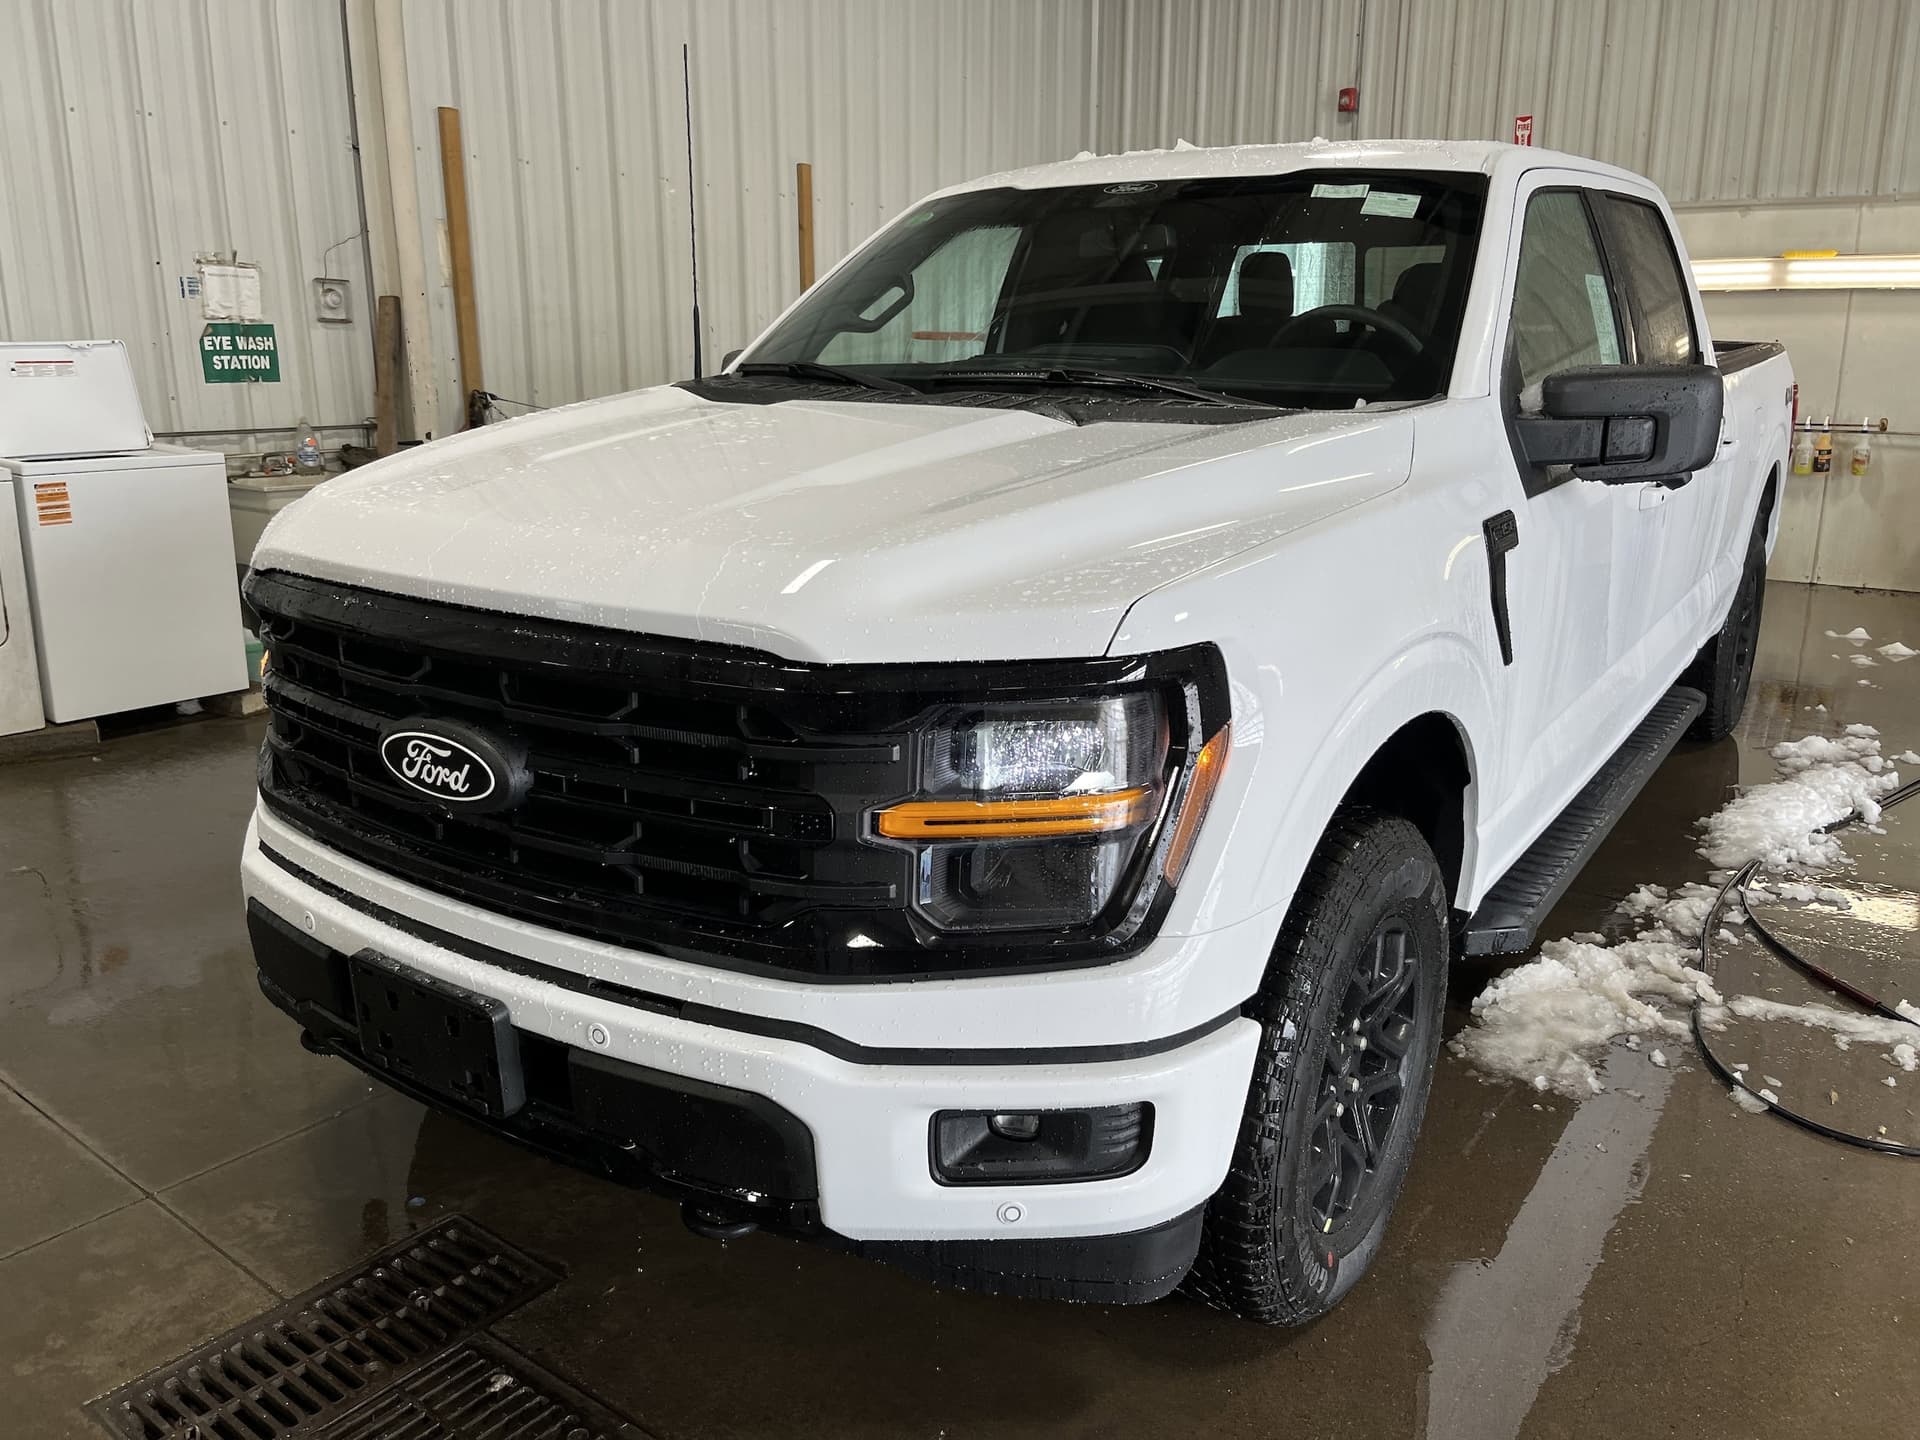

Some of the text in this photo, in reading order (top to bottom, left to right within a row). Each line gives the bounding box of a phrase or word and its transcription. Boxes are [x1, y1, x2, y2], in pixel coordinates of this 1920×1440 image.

[203, 336, 274, 350] EYE WASH
[212, 355, 270, 370] STATION
[402, 739, 470, 793] Ford
